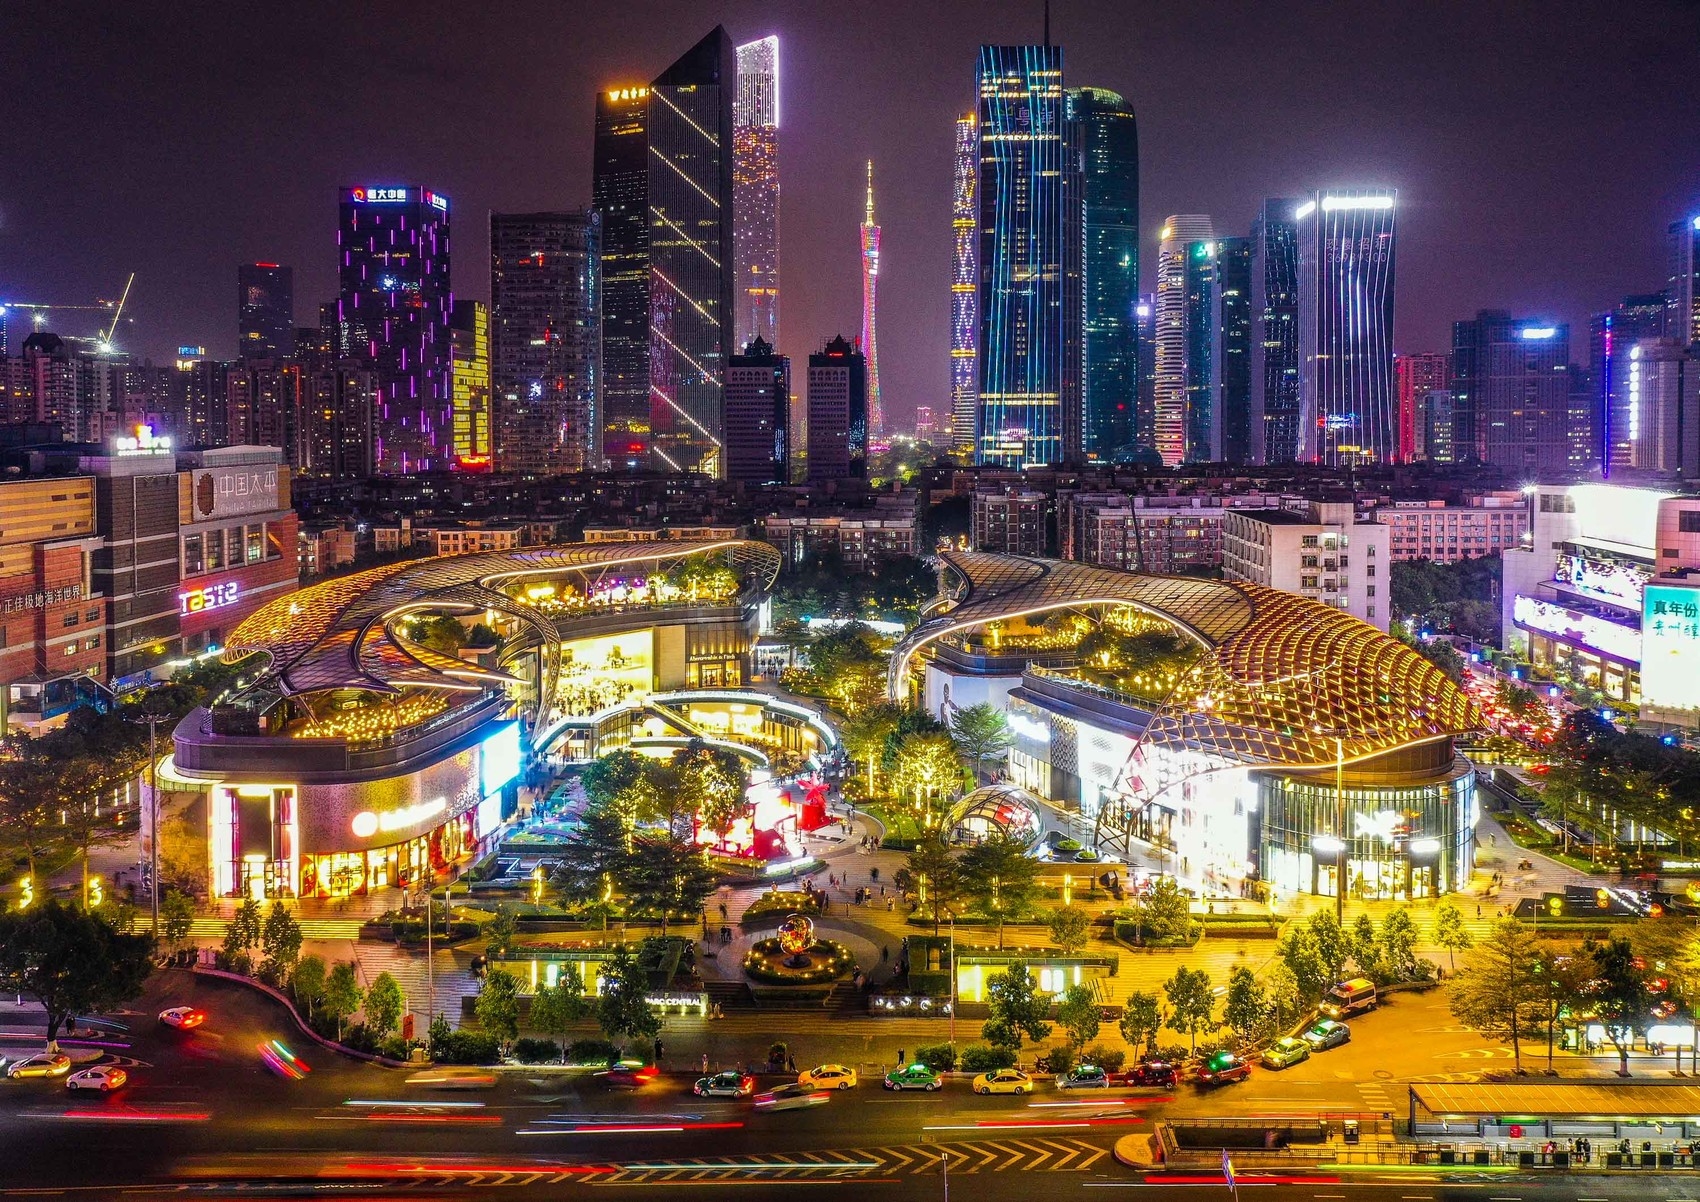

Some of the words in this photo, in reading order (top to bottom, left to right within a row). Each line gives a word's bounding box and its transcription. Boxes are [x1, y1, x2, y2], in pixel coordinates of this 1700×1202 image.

[219, 470, 276, 498] 中国太平
[5, 585, 80, 613] 正佳极地海洋世界
[1653, 600, 1698, 618] 真年份
[665, 997, 701, 1006] CENTRAL
